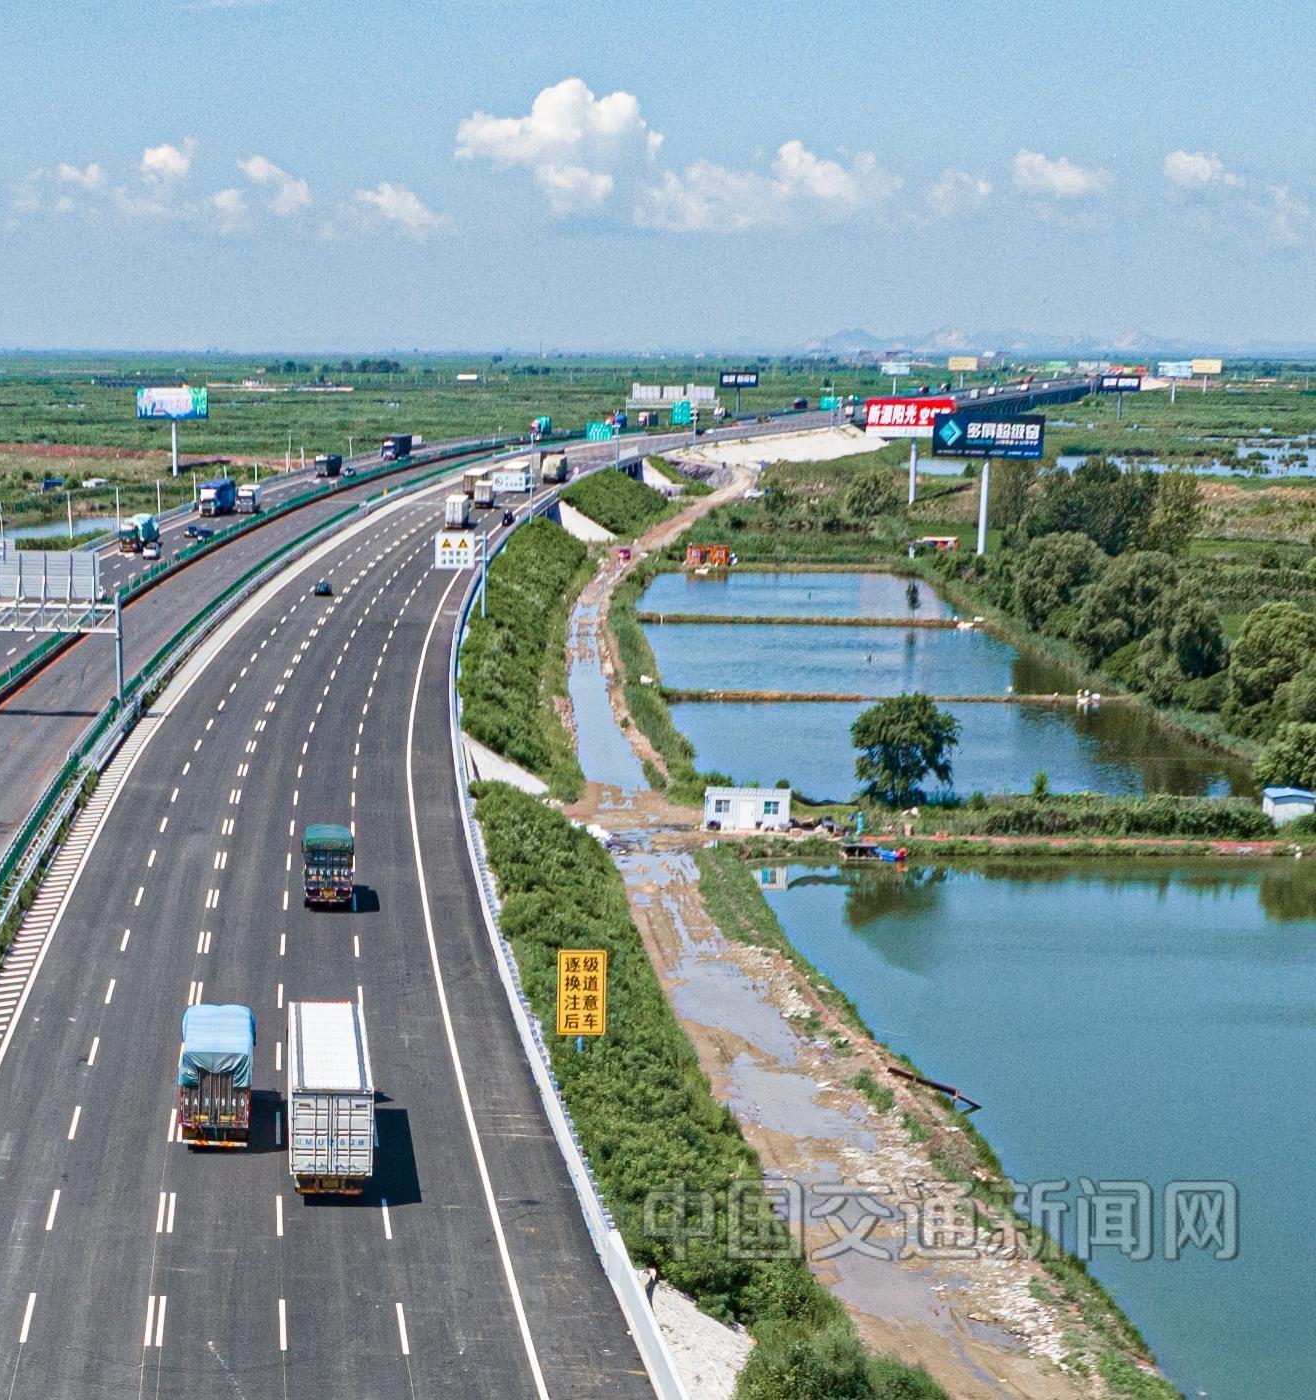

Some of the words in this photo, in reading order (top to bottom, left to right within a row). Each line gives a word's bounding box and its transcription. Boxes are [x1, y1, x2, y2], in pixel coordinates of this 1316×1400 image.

[565, 956, 599, 972] 逐级
[565, 975, 598, 991] 换道
[565, 994, 598, 1011] 注意
[564, 1013, 599, 1029] 后车
